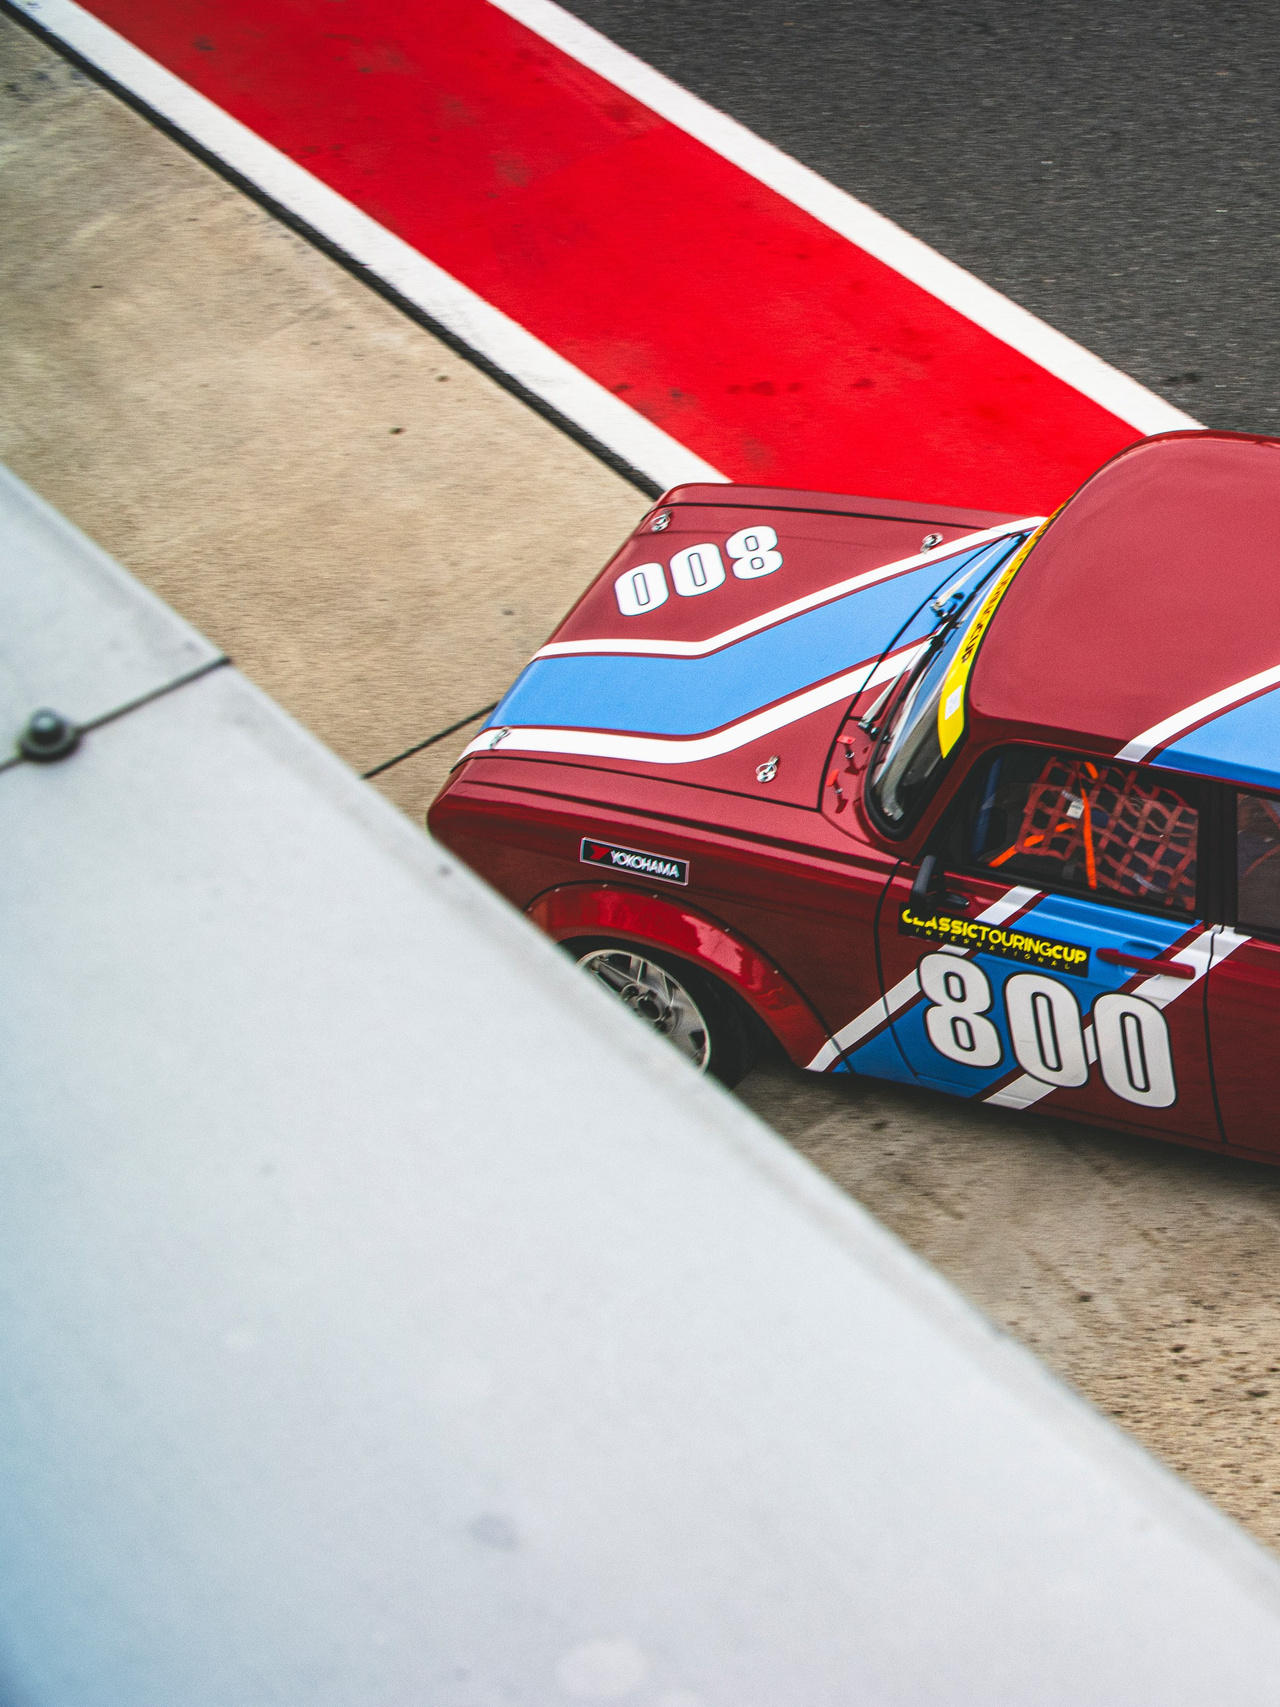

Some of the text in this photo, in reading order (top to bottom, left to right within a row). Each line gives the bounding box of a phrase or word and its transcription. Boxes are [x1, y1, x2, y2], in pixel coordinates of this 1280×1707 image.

[614, 525, 783, 616] 800
[610, 850, 680, 878] YOKOHAMA
[916, 951, 1178, 1109] 800
